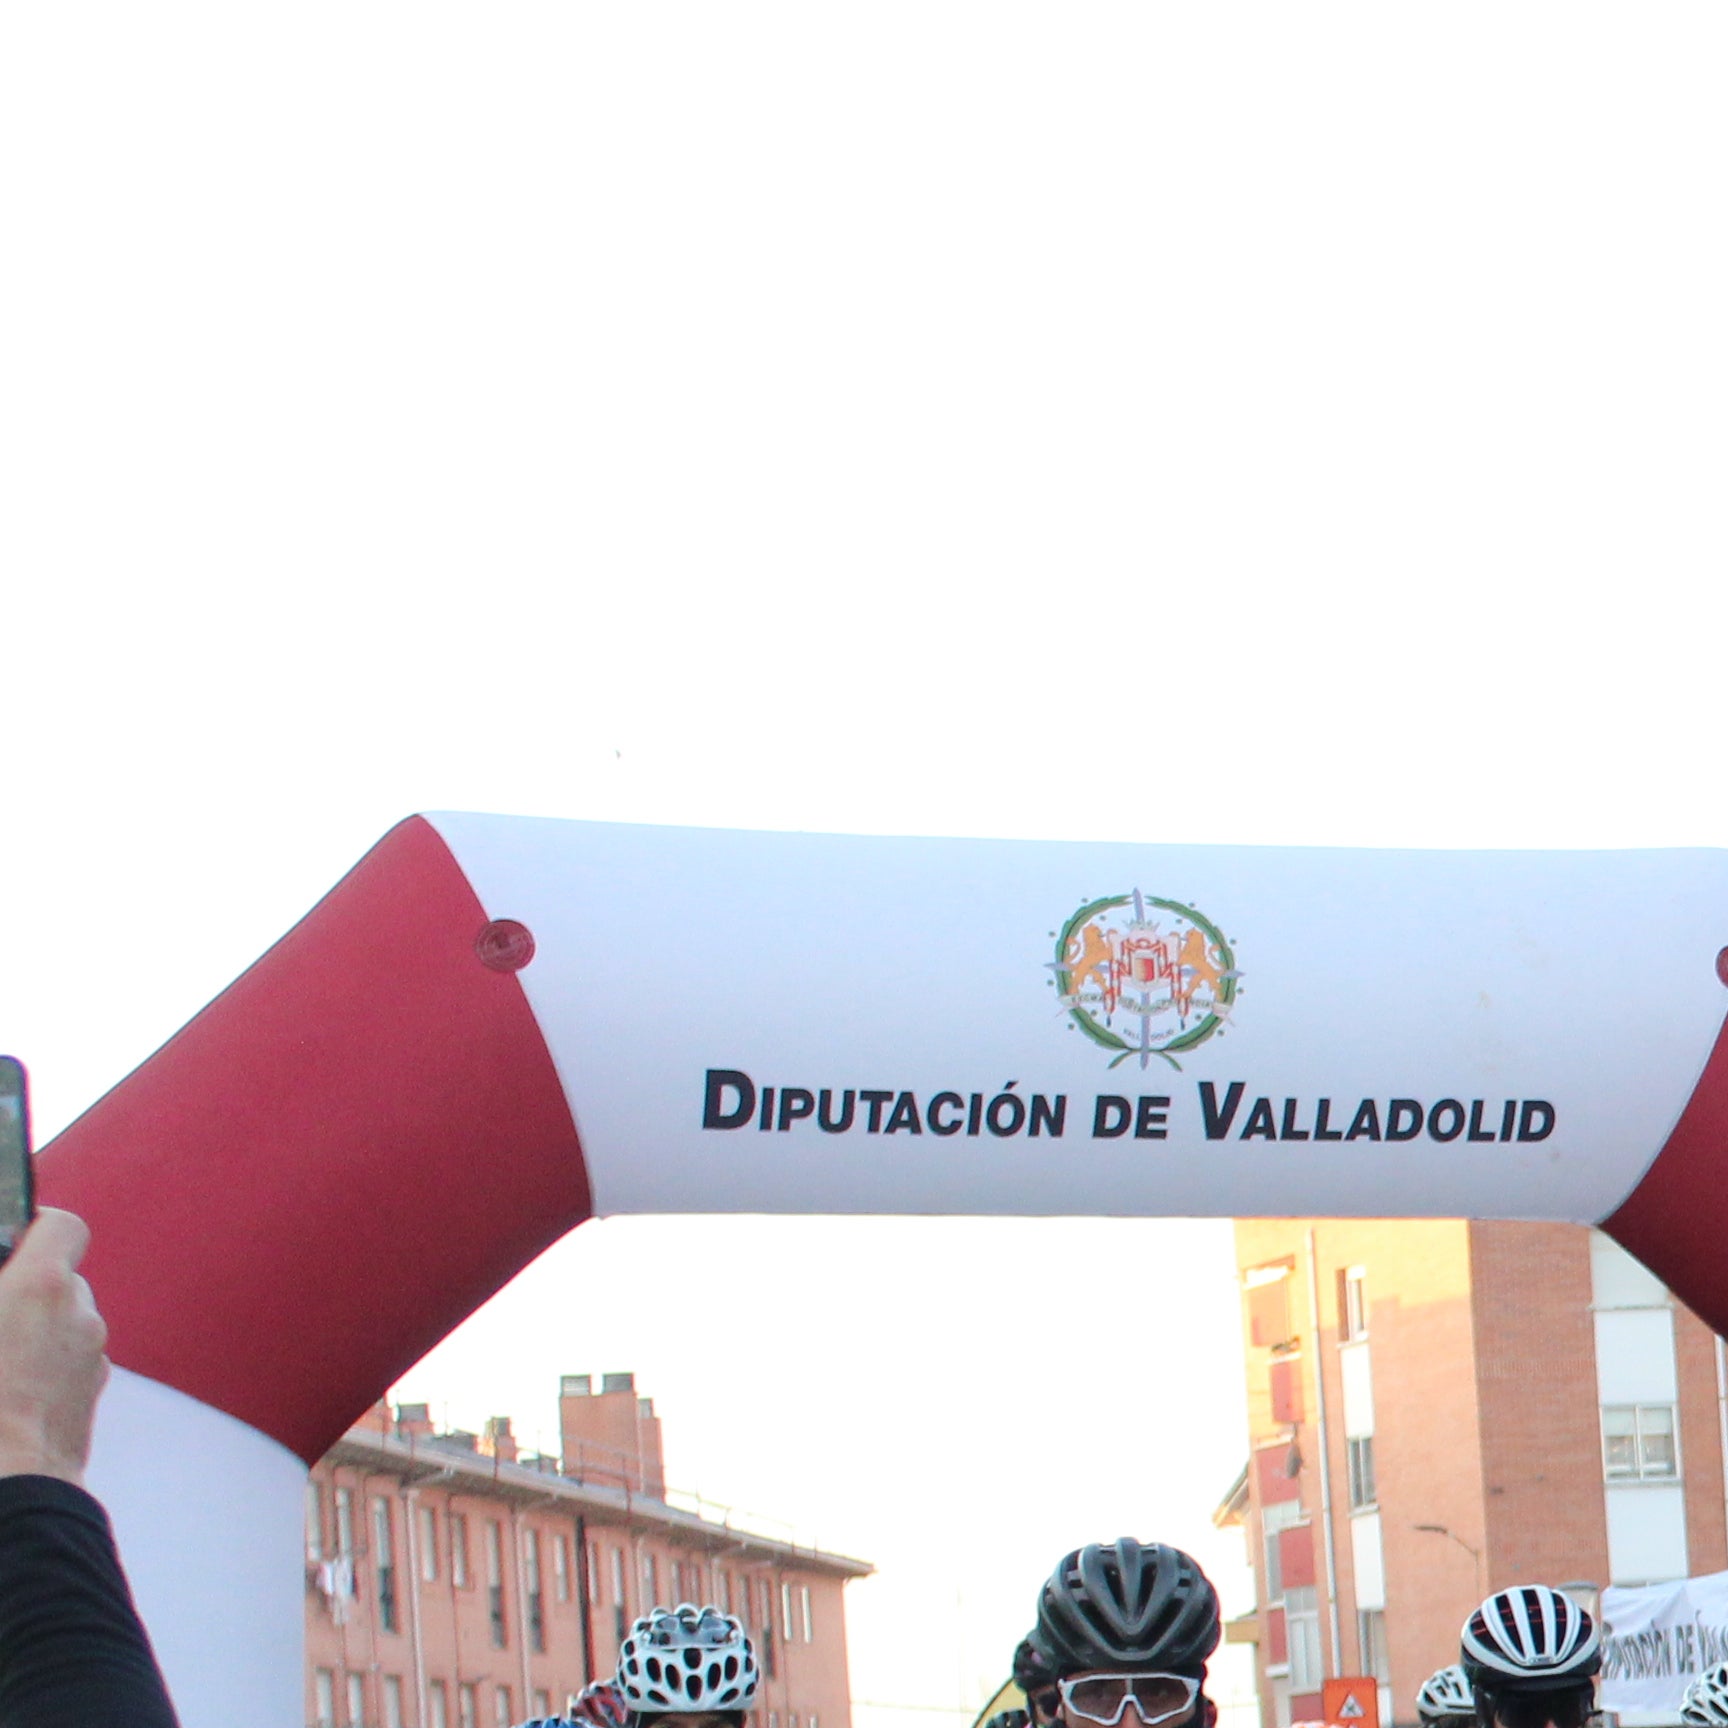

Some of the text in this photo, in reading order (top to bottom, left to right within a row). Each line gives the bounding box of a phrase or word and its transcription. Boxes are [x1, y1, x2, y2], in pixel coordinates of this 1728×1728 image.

[701, 1068, 1556, 1145] DIPUTACIÓN DE VALLADOLID
